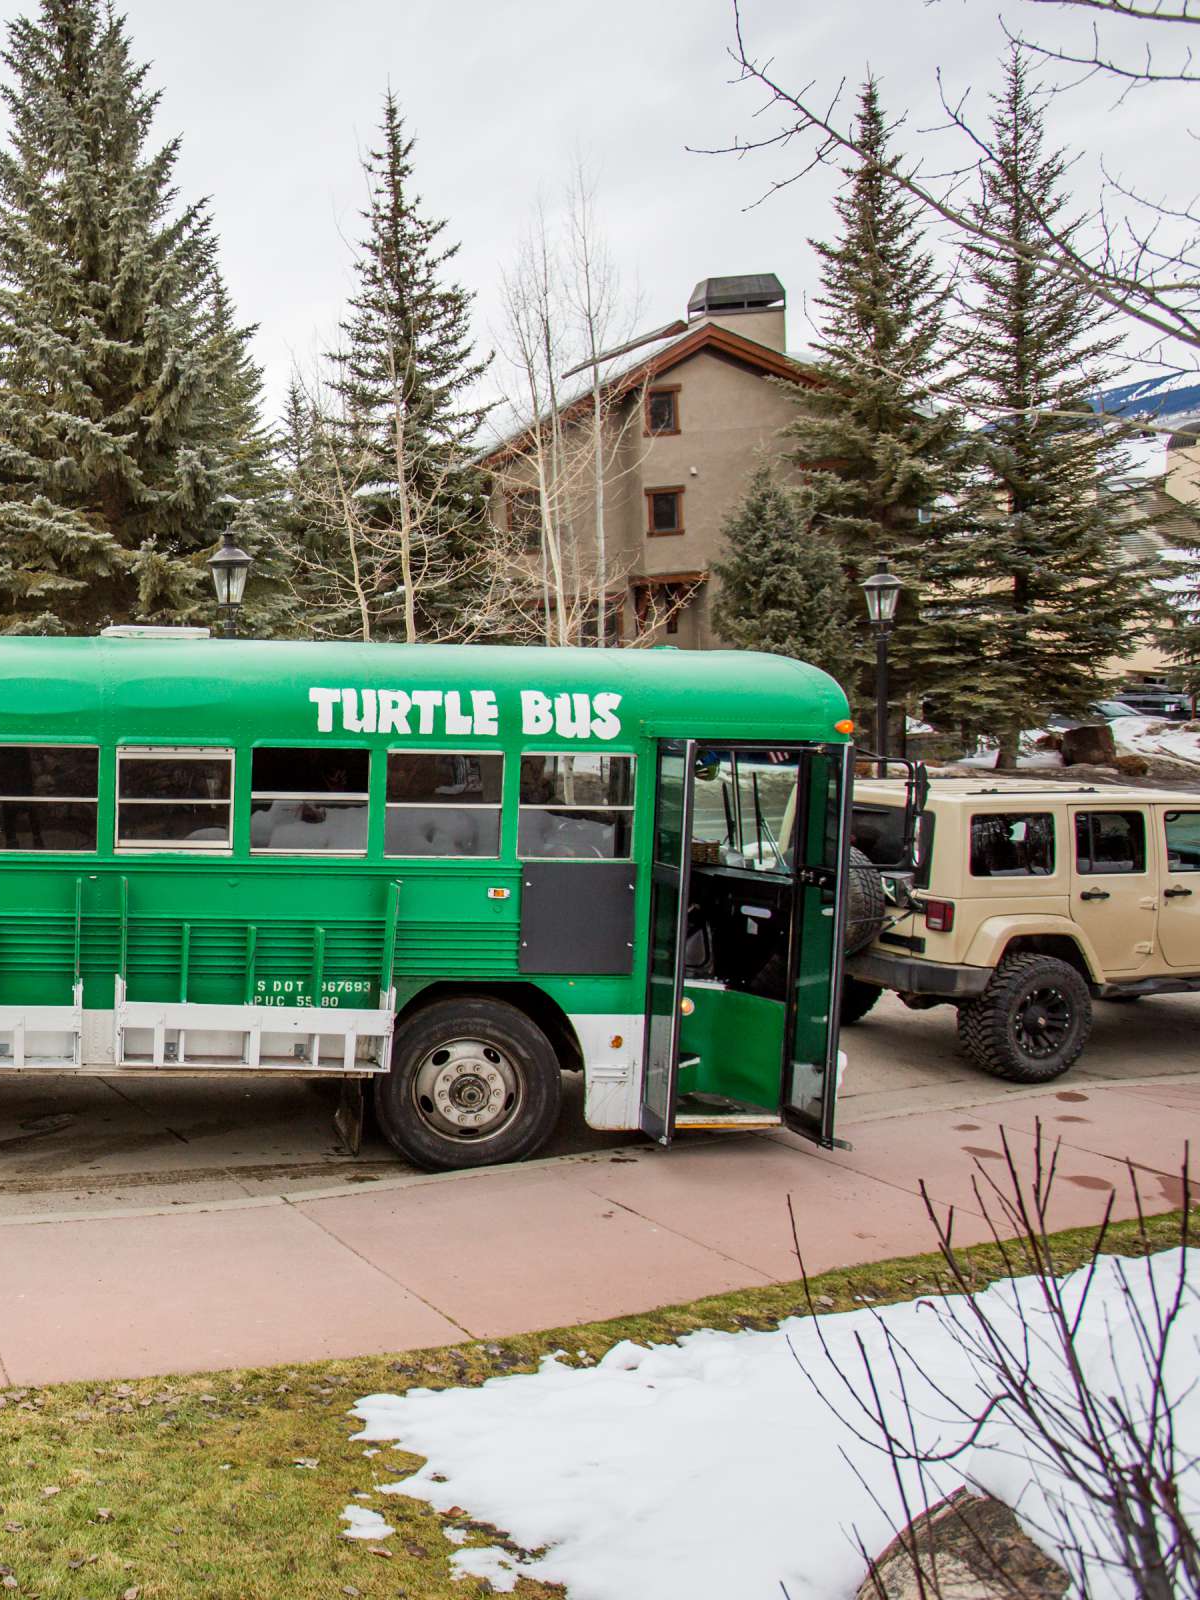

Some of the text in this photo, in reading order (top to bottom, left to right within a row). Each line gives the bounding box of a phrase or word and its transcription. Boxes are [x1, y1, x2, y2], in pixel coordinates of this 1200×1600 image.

[308, 687, 623, 740] TURTLE BUS
[273, 980, 305, 993] DOT
[254, 995, 286, 1007] PUC
